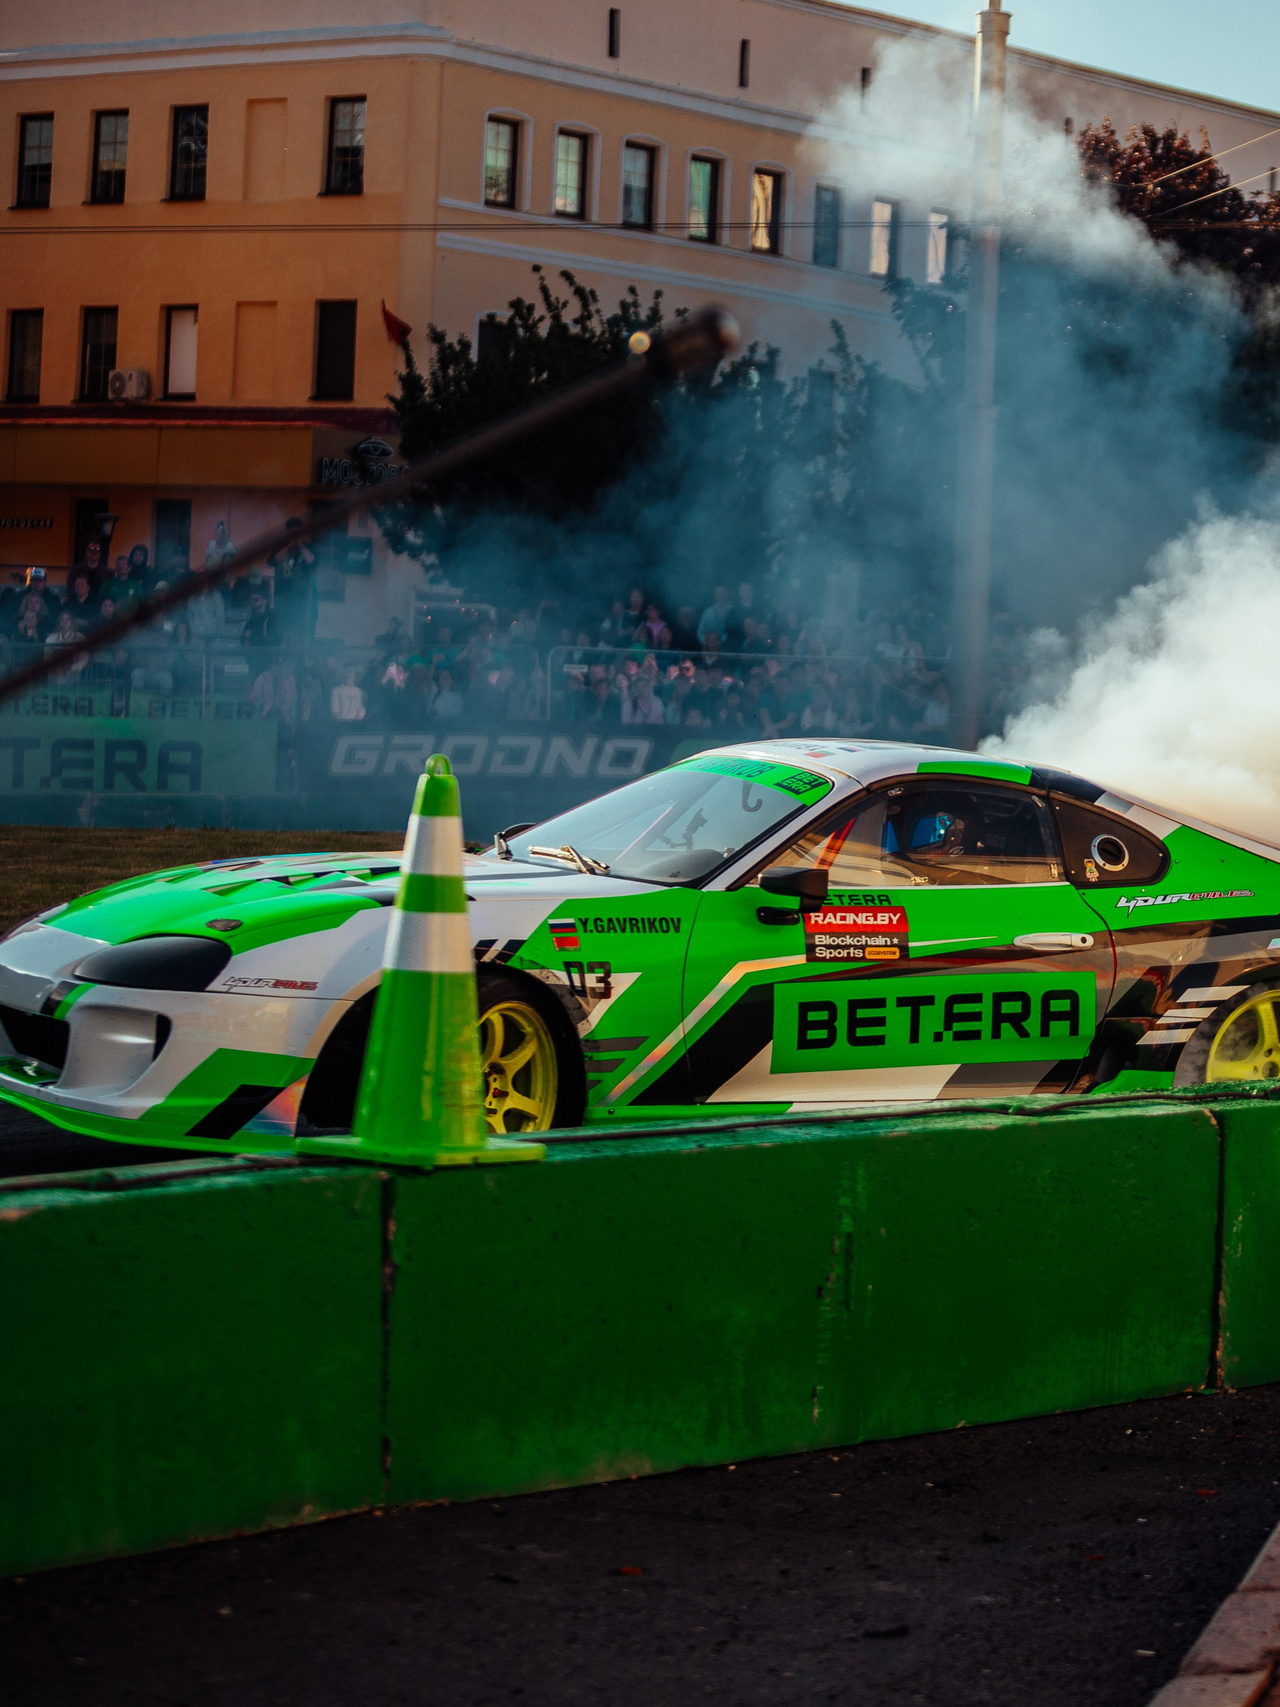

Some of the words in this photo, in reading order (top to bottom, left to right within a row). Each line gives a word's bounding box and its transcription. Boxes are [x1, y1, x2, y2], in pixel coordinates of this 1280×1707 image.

[329, 731, 654, 777] GRODNO
[578, 917, 682, 934] Y.GAVRIKOV
[809, 912, 902, 925] RACING.BY
[814, 934, 891, 946] Blockchain
[815, 946, 864, 959] Sports
[796, 988, 1080, 1051] BET.ERA
